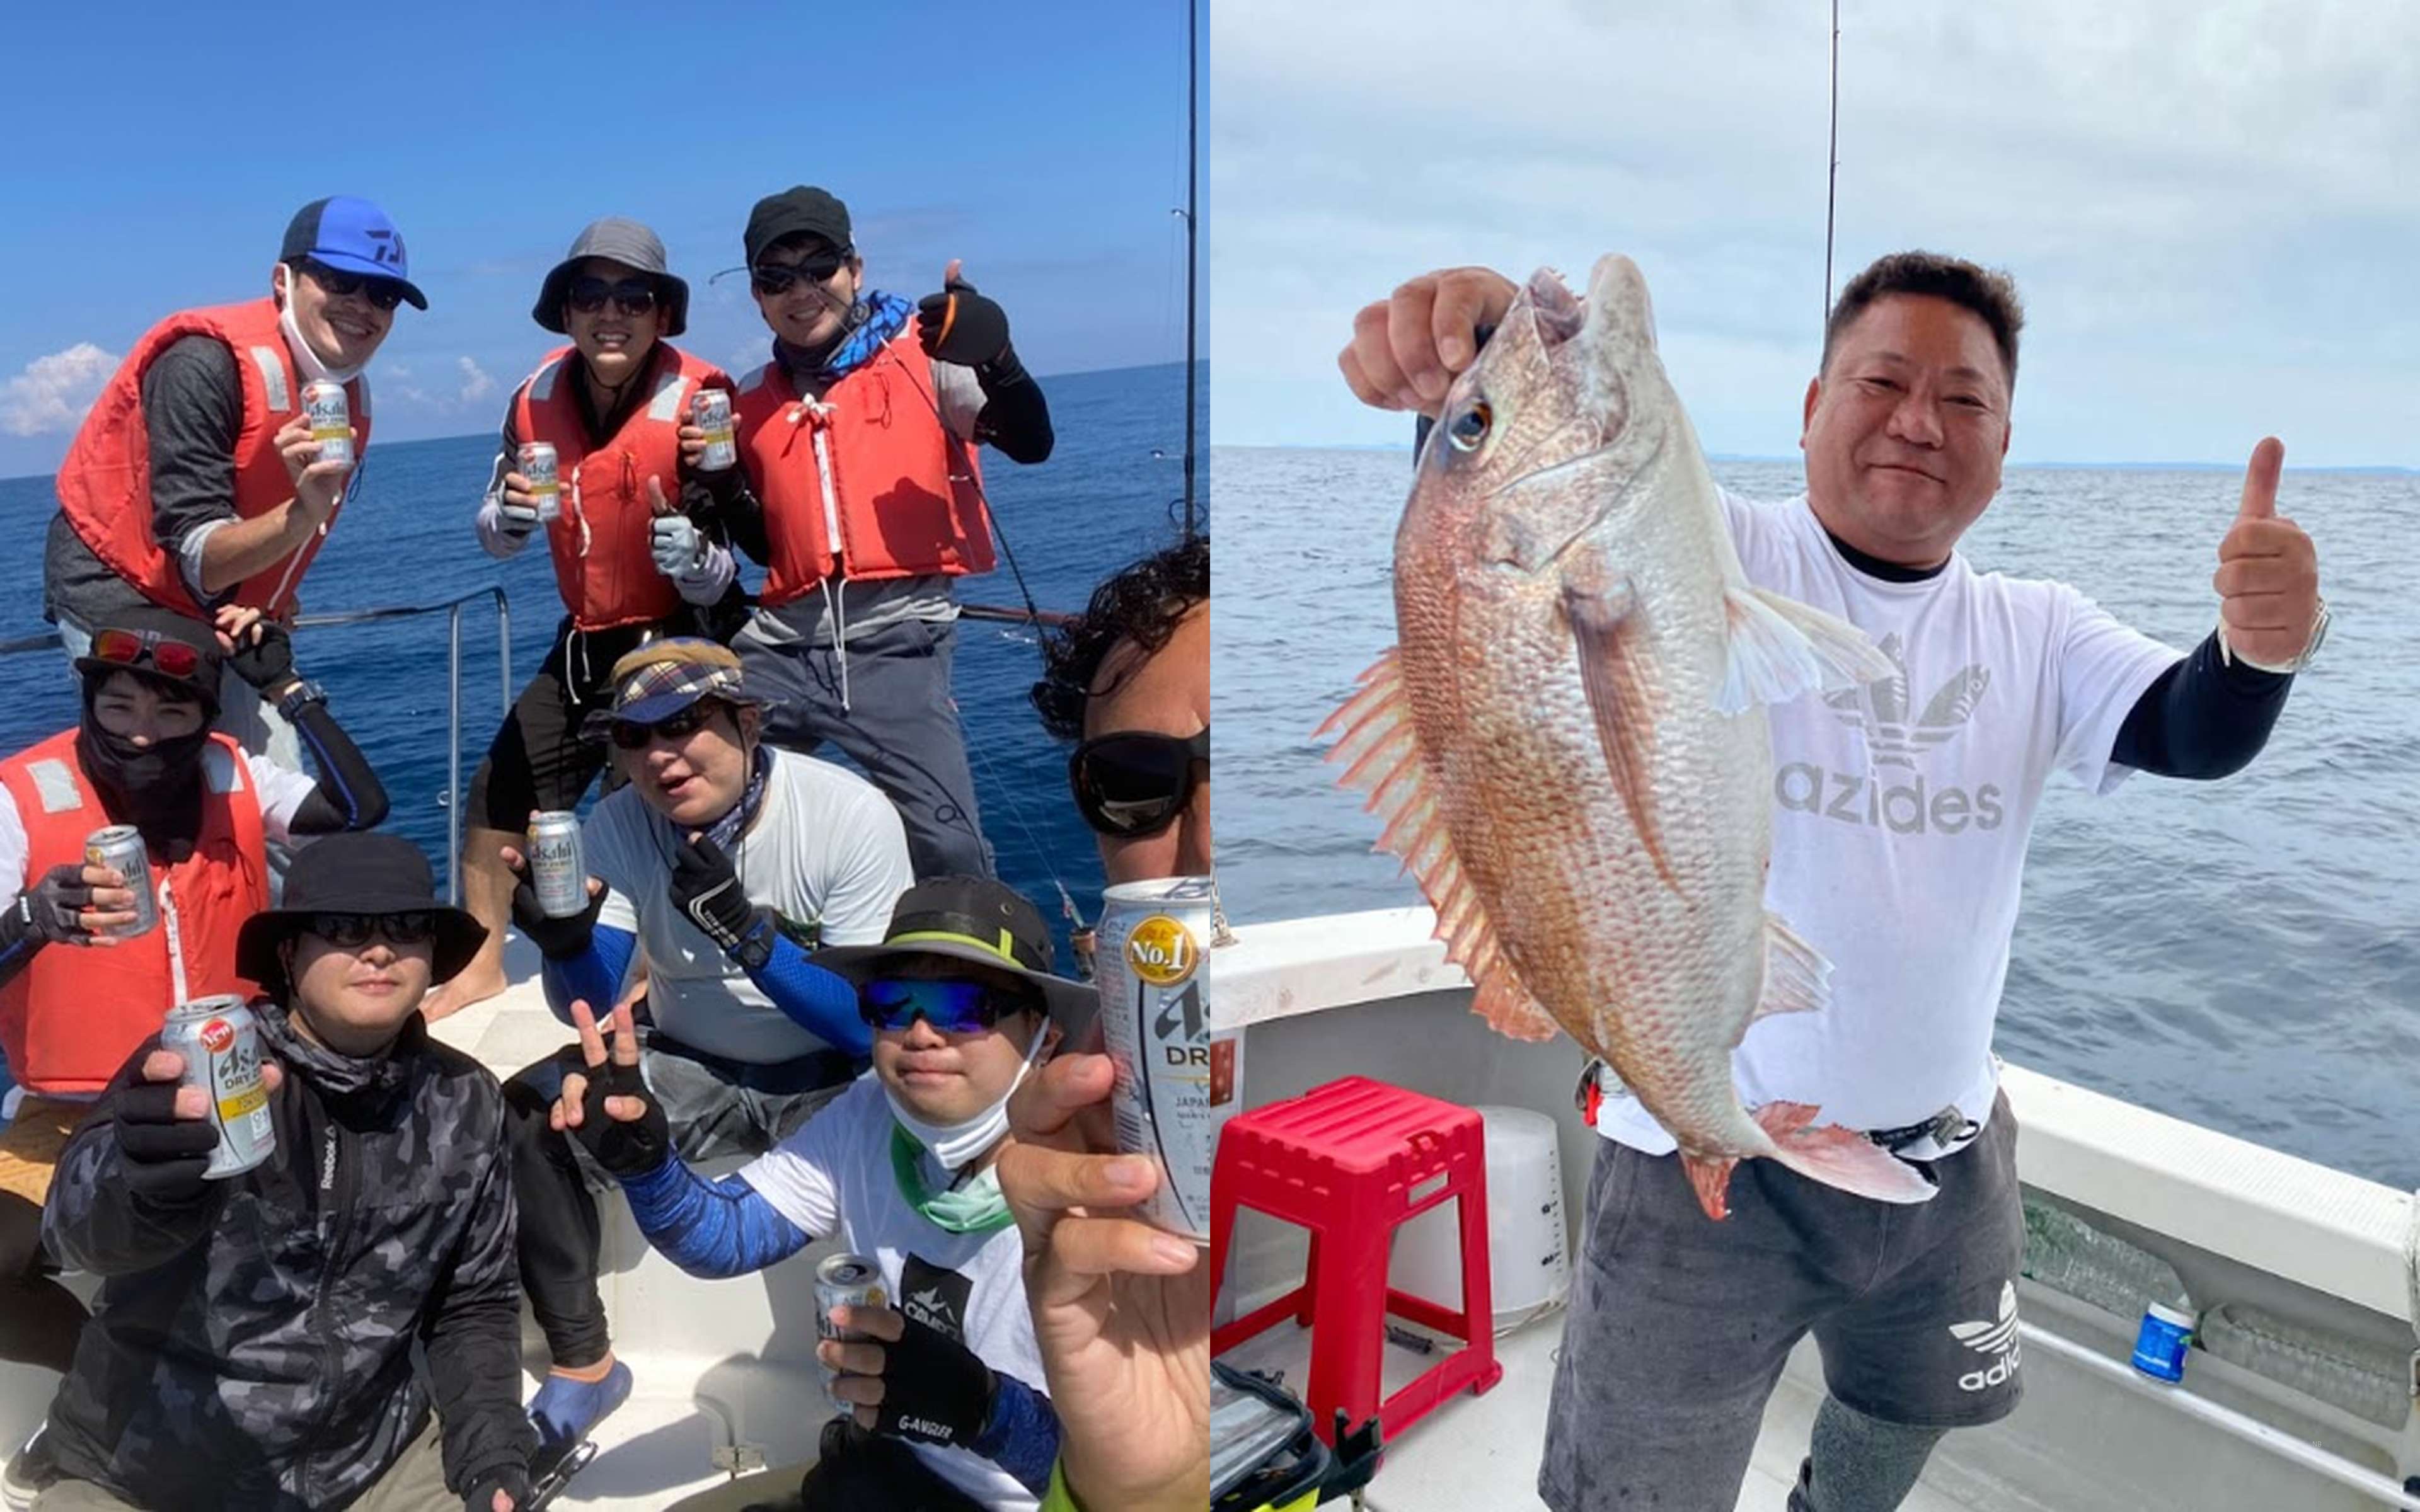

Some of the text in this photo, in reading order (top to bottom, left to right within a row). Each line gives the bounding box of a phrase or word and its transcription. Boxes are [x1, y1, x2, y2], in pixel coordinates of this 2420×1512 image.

[1775, 761, 2003, 835] azides
[1130, 934, 1184, 968] No.1
[224, 1072, 250, 1091] DRY
[320, 1139, 337, 1189] Reebok
